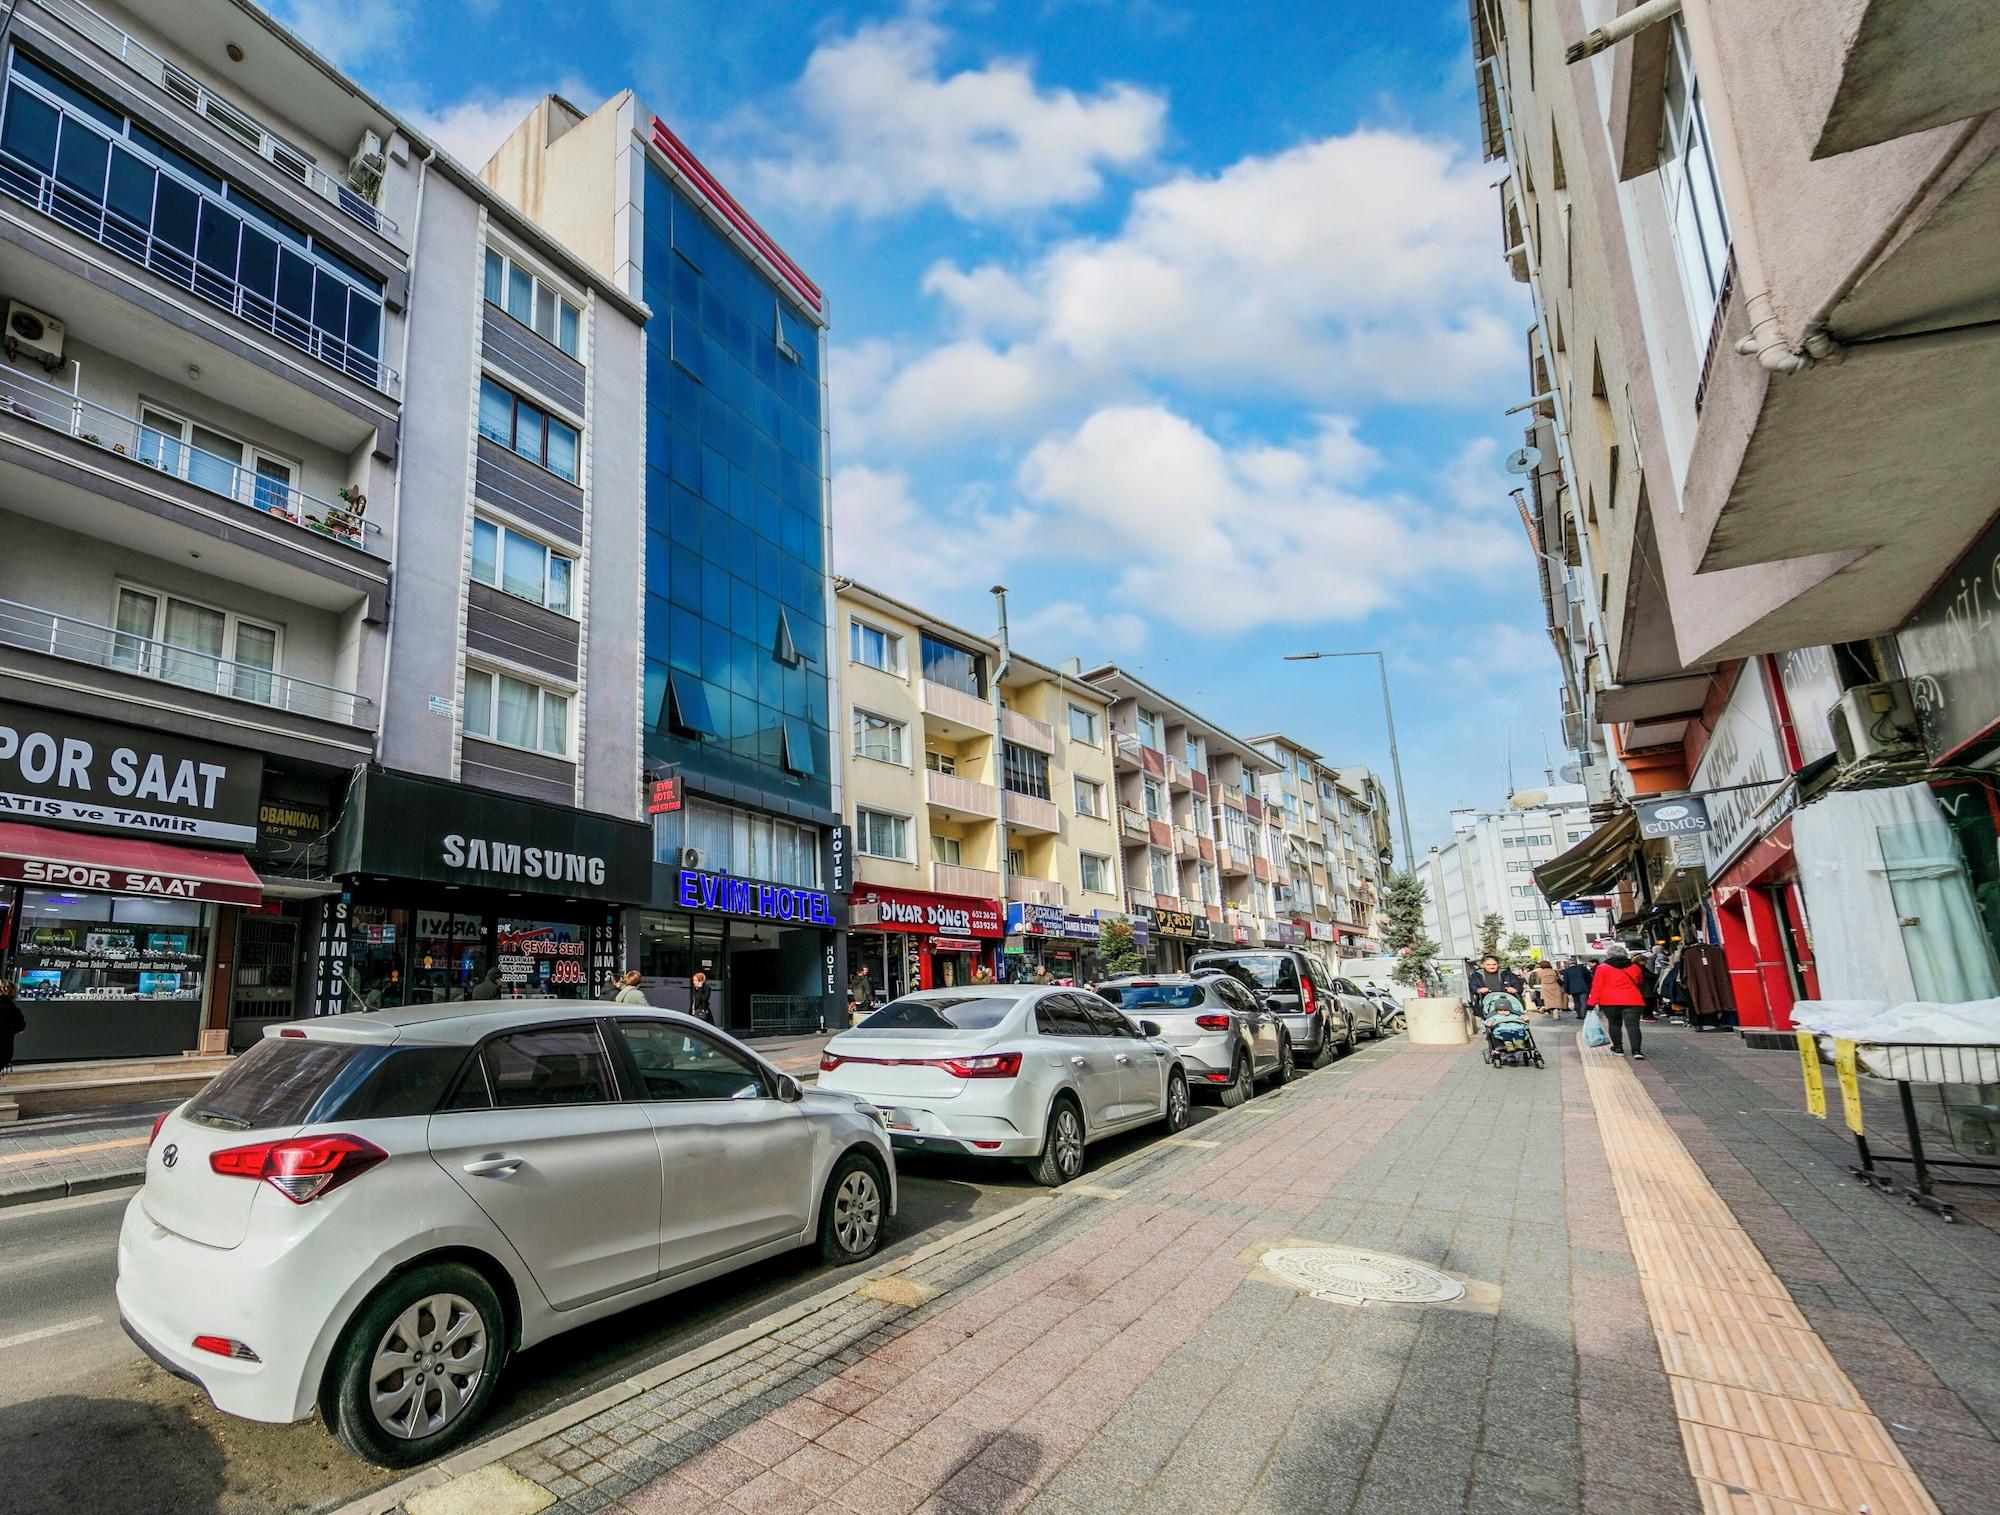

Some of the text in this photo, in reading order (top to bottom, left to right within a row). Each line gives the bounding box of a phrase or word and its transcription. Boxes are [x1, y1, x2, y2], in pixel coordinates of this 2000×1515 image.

[107, 747, 226, 809] SAAT
[73, 808, 104, 820] ve
[114, 811, 197, 832] TAMİR
[1645, 816, 1706, 833] GÜMÜŞ
[442, 834, 606, 885] SAMSUNG
[832, 828, 842, 892] HOTEL
[23, 861, 202, 897] SPOR SAAT
[679, 869, 836, 926] EVİM HOTEL
[881, 900, 970, 928] DİYAR DÖNER
[972, 911, 982, 919] 652
[972, 921, 983, 929] 653
[521, 939, 584, 955] ÇEYİZ SETİ
[40, 959, 50, 967] Pil
[75, 960, 89, 968] Cam
[139, 962, 151, 970] Saat
[827, 946, 835, 994] HOTEL
